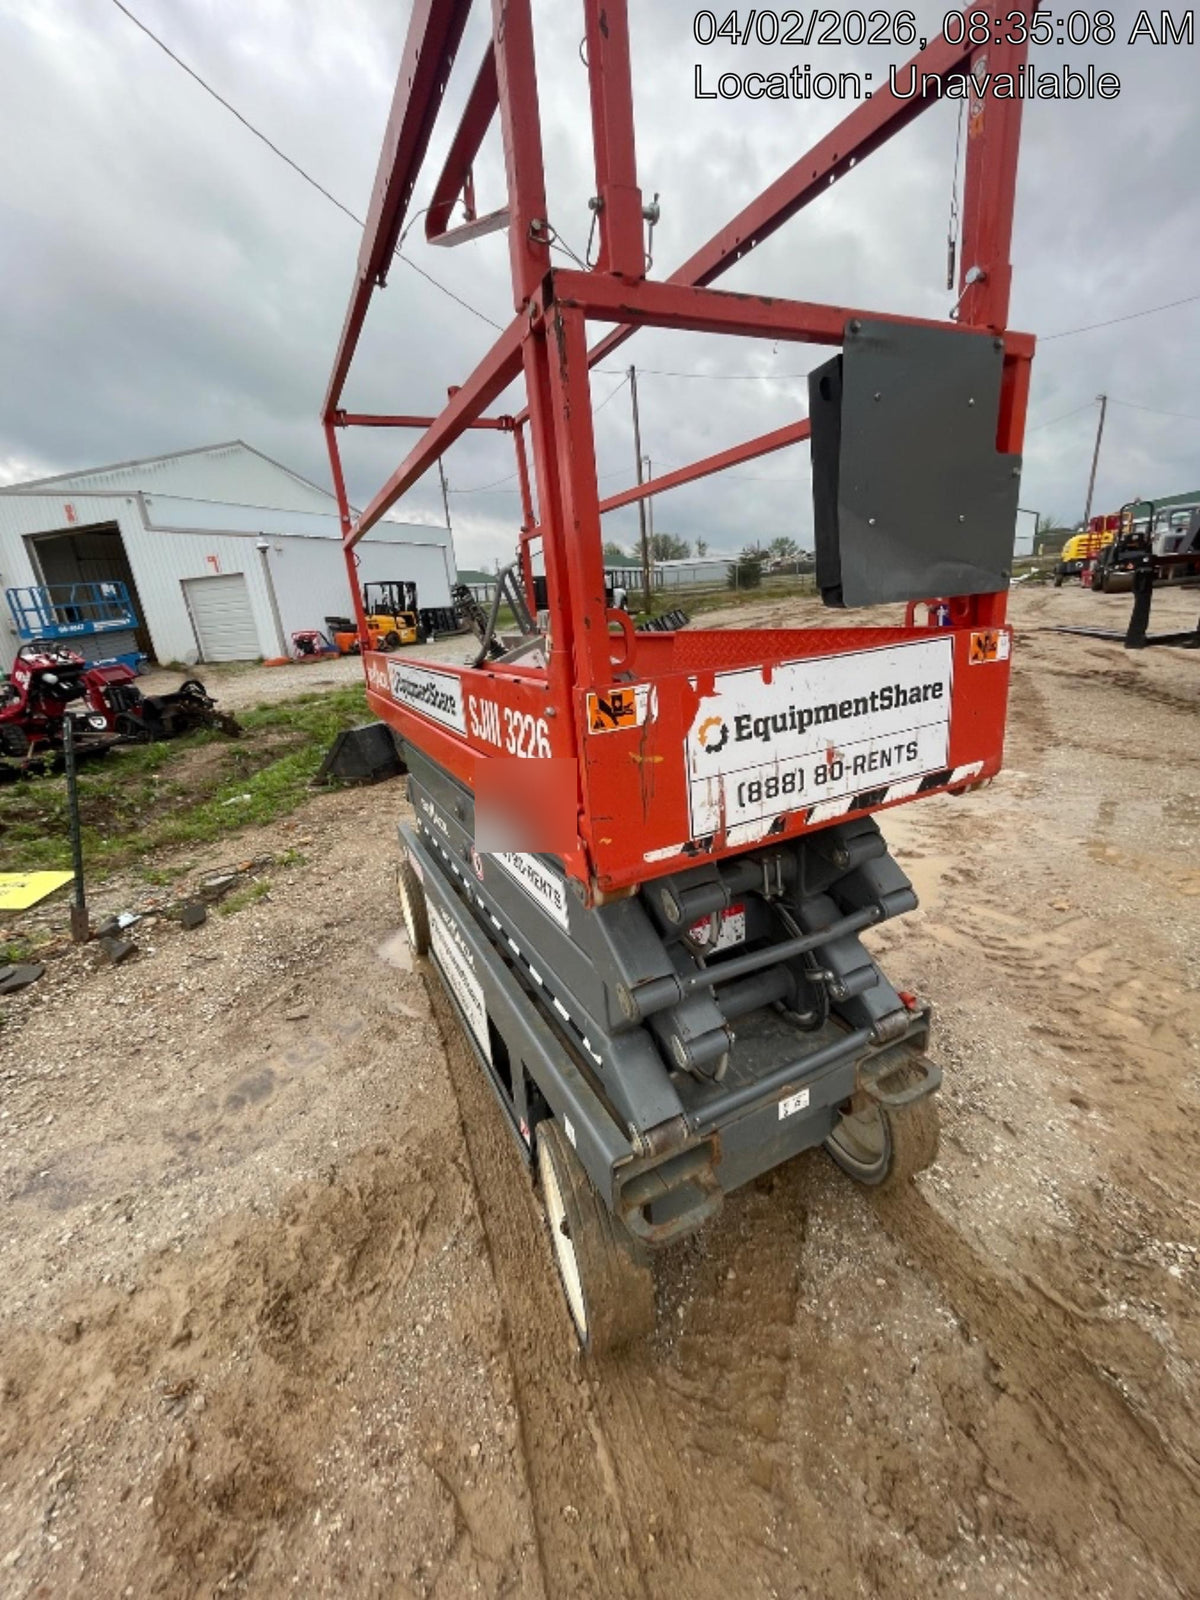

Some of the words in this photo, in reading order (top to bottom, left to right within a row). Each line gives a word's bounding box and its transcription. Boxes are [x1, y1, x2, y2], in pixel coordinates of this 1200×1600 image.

[504, 707, 552, 758] 3226
[734, 682, 944, 743] EquipmentShare
[737, 768, 805, 808] (888)
[814, 741, 919, 786] 80-RENTS
